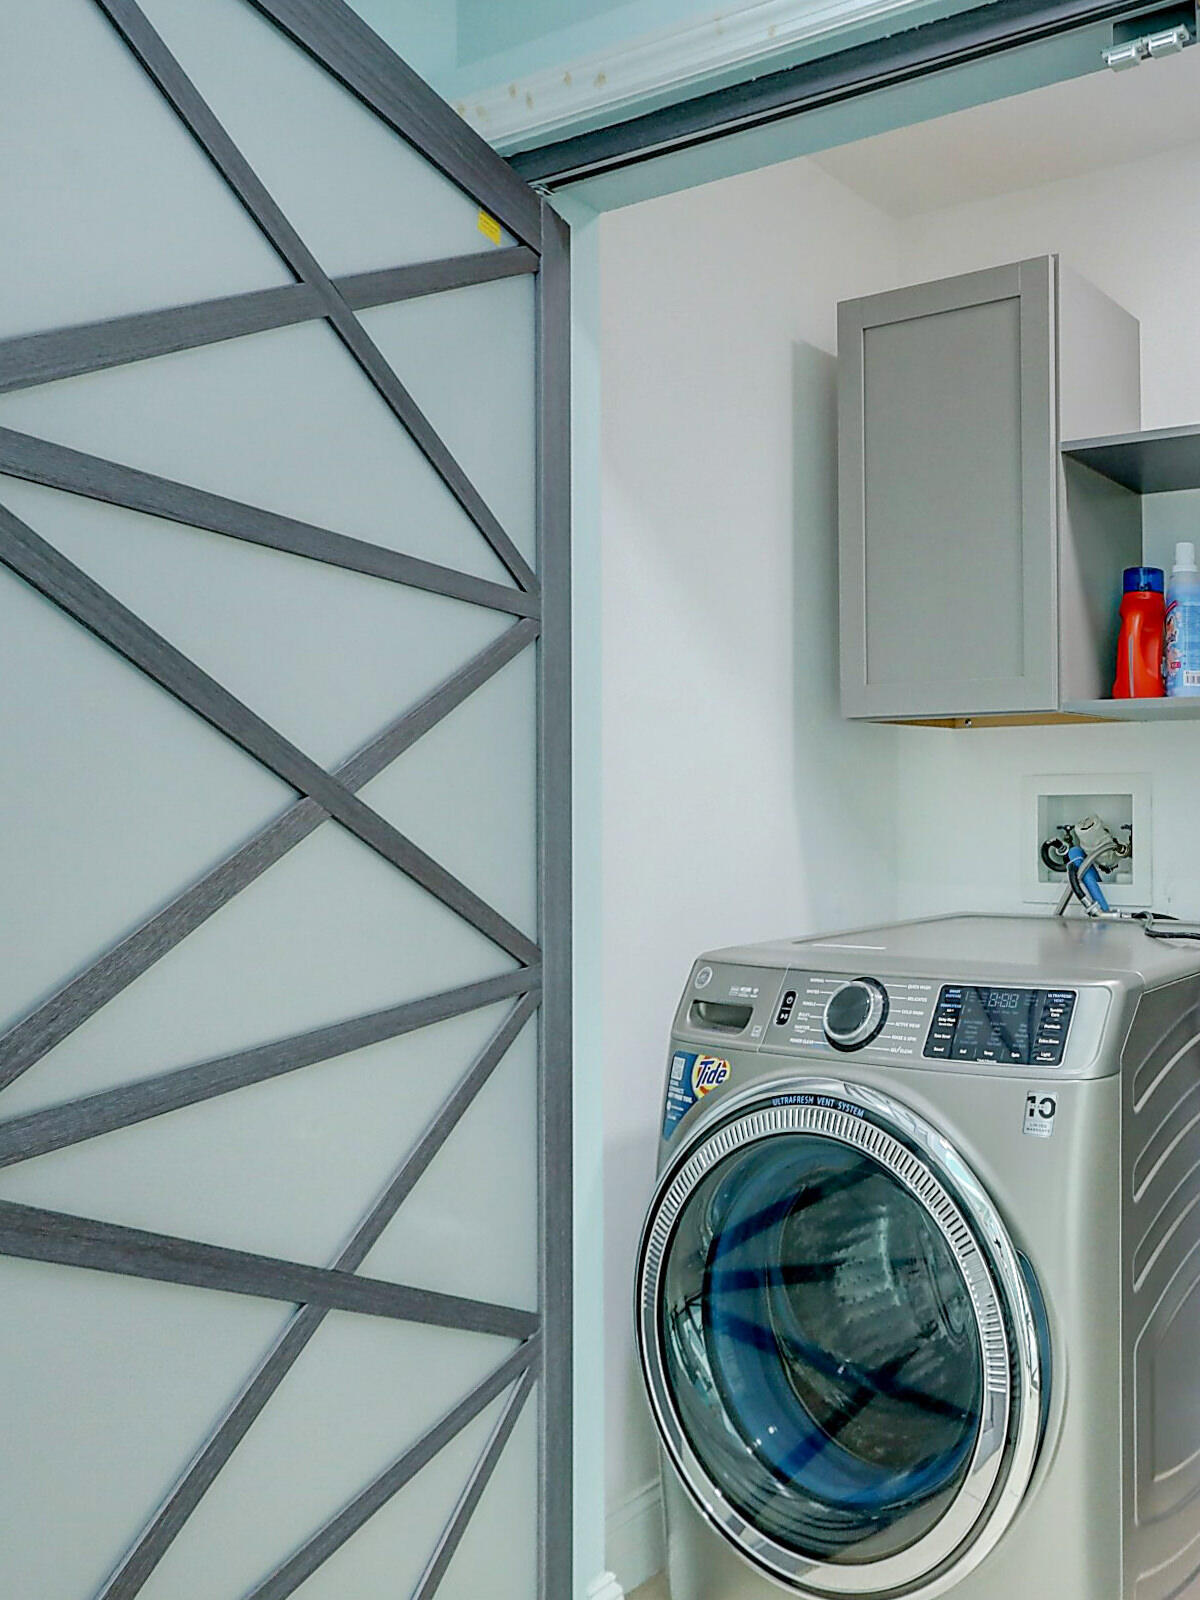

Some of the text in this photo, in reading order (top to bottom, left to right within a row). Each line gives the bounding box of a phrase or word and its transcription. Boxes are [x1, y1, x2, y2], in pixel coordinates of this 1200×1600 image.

[696, 1060, 728, 1089] Tide
[772, 1095, 865, 1118] ULTRAFRESH VENT SYSTEM
[1027, 1095, 1057, 1119] 10
